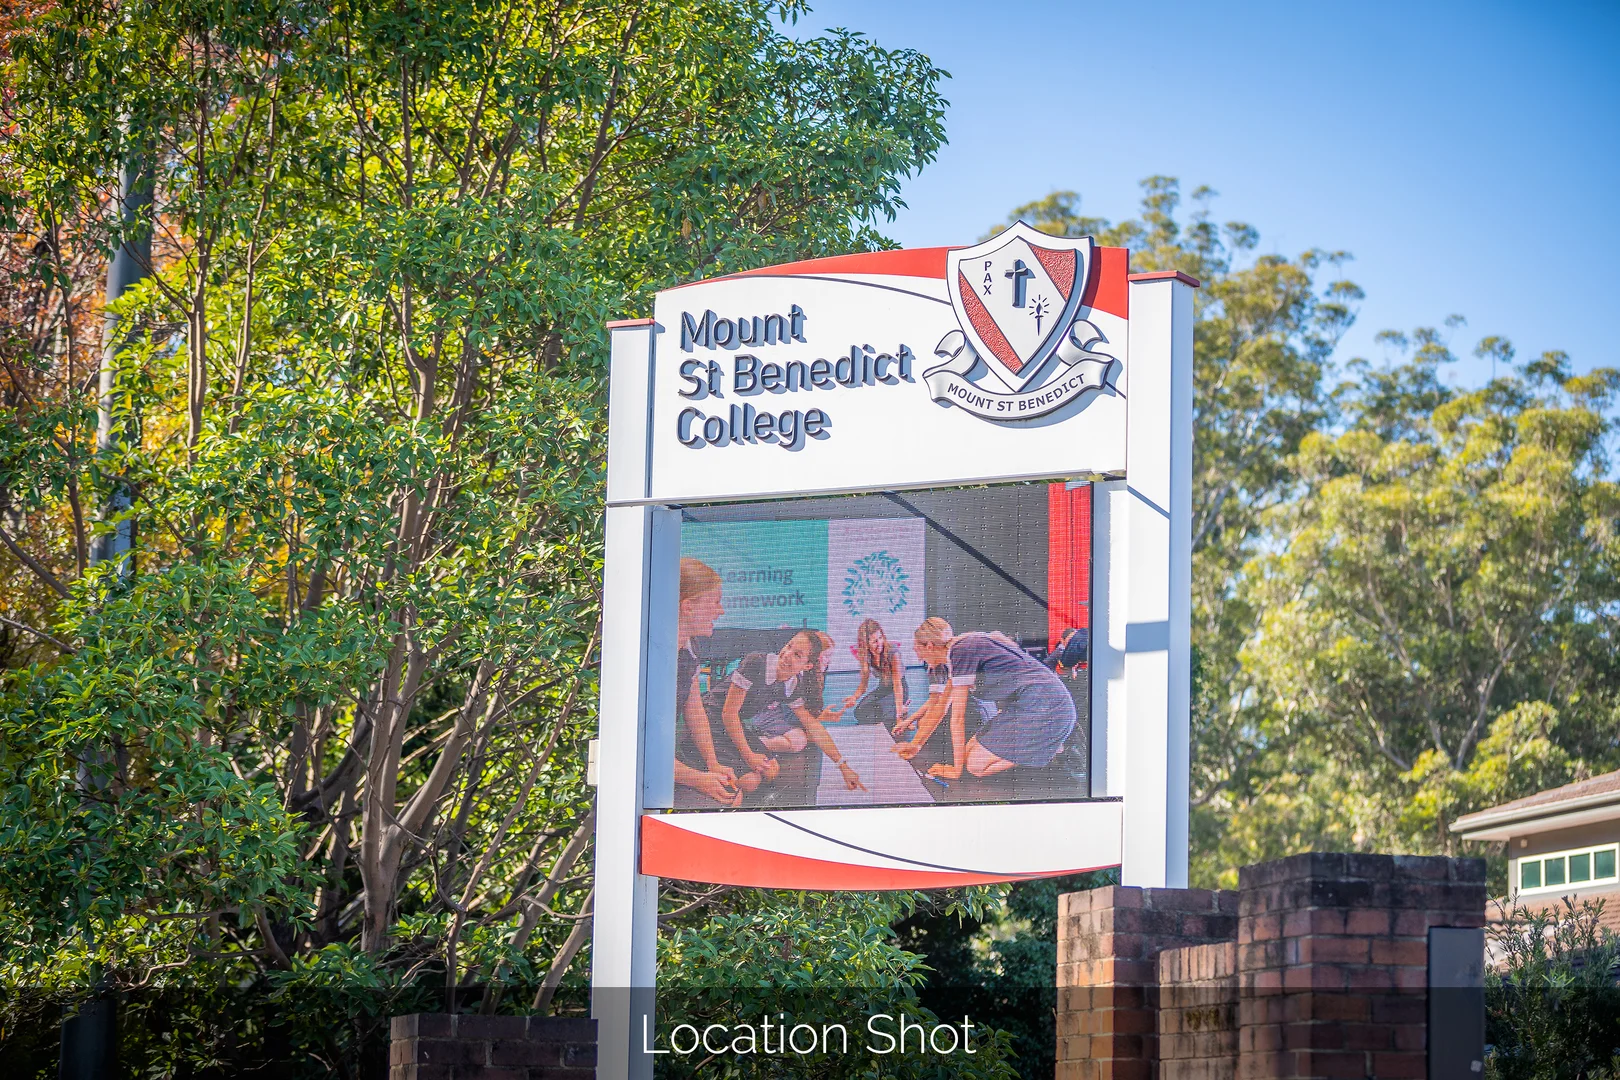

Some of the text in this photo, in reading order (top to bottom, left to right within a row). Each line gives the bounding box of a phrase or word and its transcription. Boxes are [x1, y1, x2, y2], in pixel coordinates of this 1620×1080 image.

[983, 260, 993, 295] PAX
[680, 304, 808, 353] Mount
[677, 343, 916, 400] St Benedict
[947, 373, 1085, 412] MOUNT ST BENEDICT
[677, 402, 833, 452] College
[722, 590, 805, 609] amework
